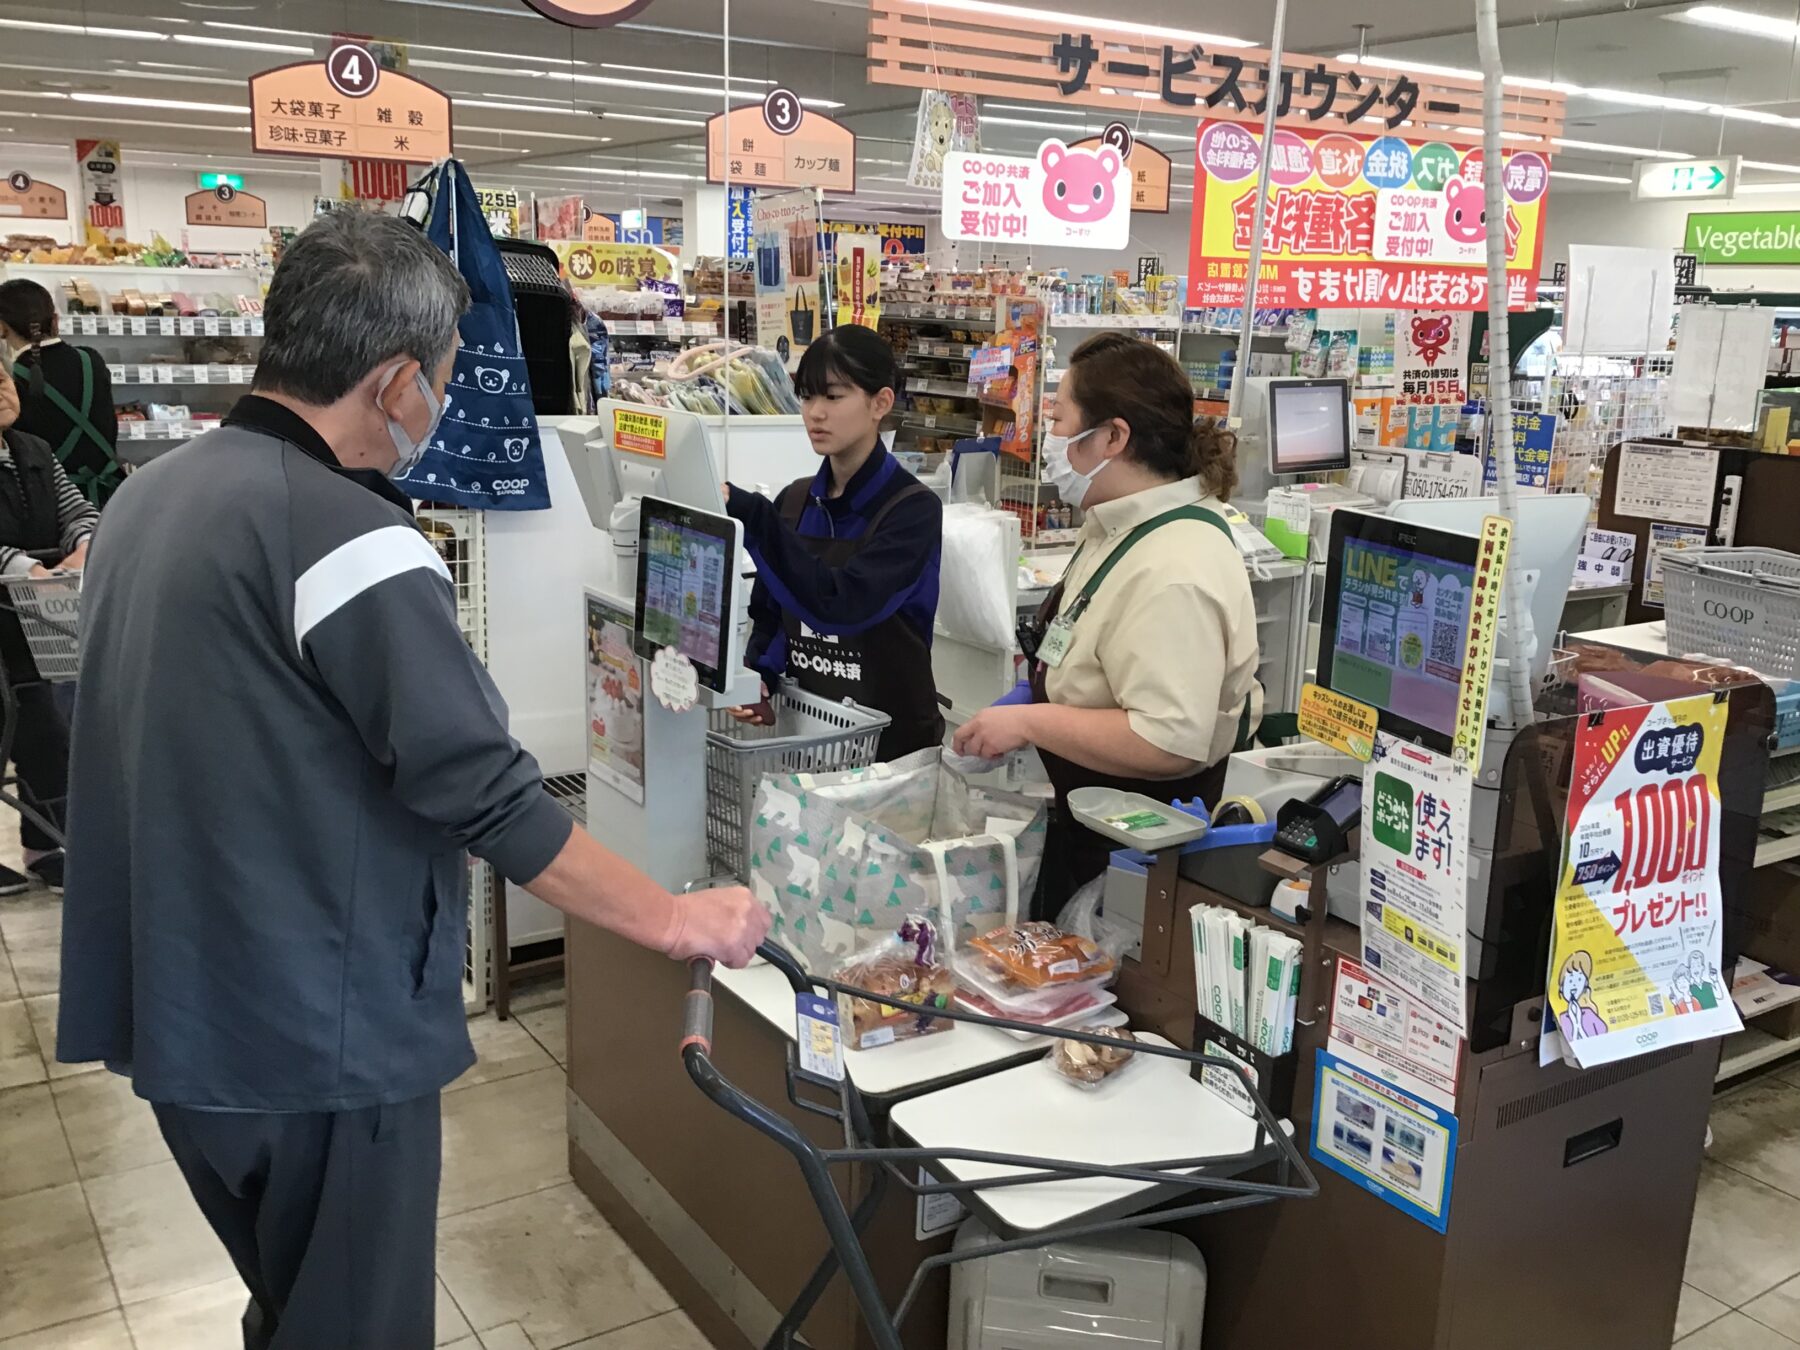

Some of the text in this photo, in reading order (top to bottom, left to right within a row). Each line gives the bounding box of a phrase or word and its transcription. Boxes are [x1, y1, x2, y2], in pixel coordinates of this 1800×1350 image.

[341, 54, 363, 86] 4
[1053, 33, 1461, 129] サービスカウンター
[271, 98, 342, 120] 大袋菓子
[775, 98, 791, 125] 3
[393, 136, 410, 151] 米
[742, 138, 754, 153] 餅
[794, 156, 841, 173] カップ麺
[221, 185, 231, 198] 3
[962, 180, 1022, 209] ご加入
[960, 210, 1028, 238] 受付中!
[1388, 211, 1431, 233] ご加入
[1385, 235, 1434, 257] 受付中!
[570, 252, 657, 279] 秋の味覚
[1402, 367, 1459, 380] 共済の締切は
[1402, 380, 1460, 395] 毎月15日
[492, 478, 530, 490] COOP
[1595, 563, 1604, 573] 中
[1641, 730, 1699, 762] 出資優待
[1670, 755, 1694, 769] サービス
[1375, 807, 1410, 834] ポイント
[1415, 789, 1454, 841] 使え
[1611, 773, 1711, 896] 1,000
[1415, 829, 1453, 877] ます!
[1681, 868, 1706, 885] ポイント
[1612, 890, 1708, 937] プレゼント!!
